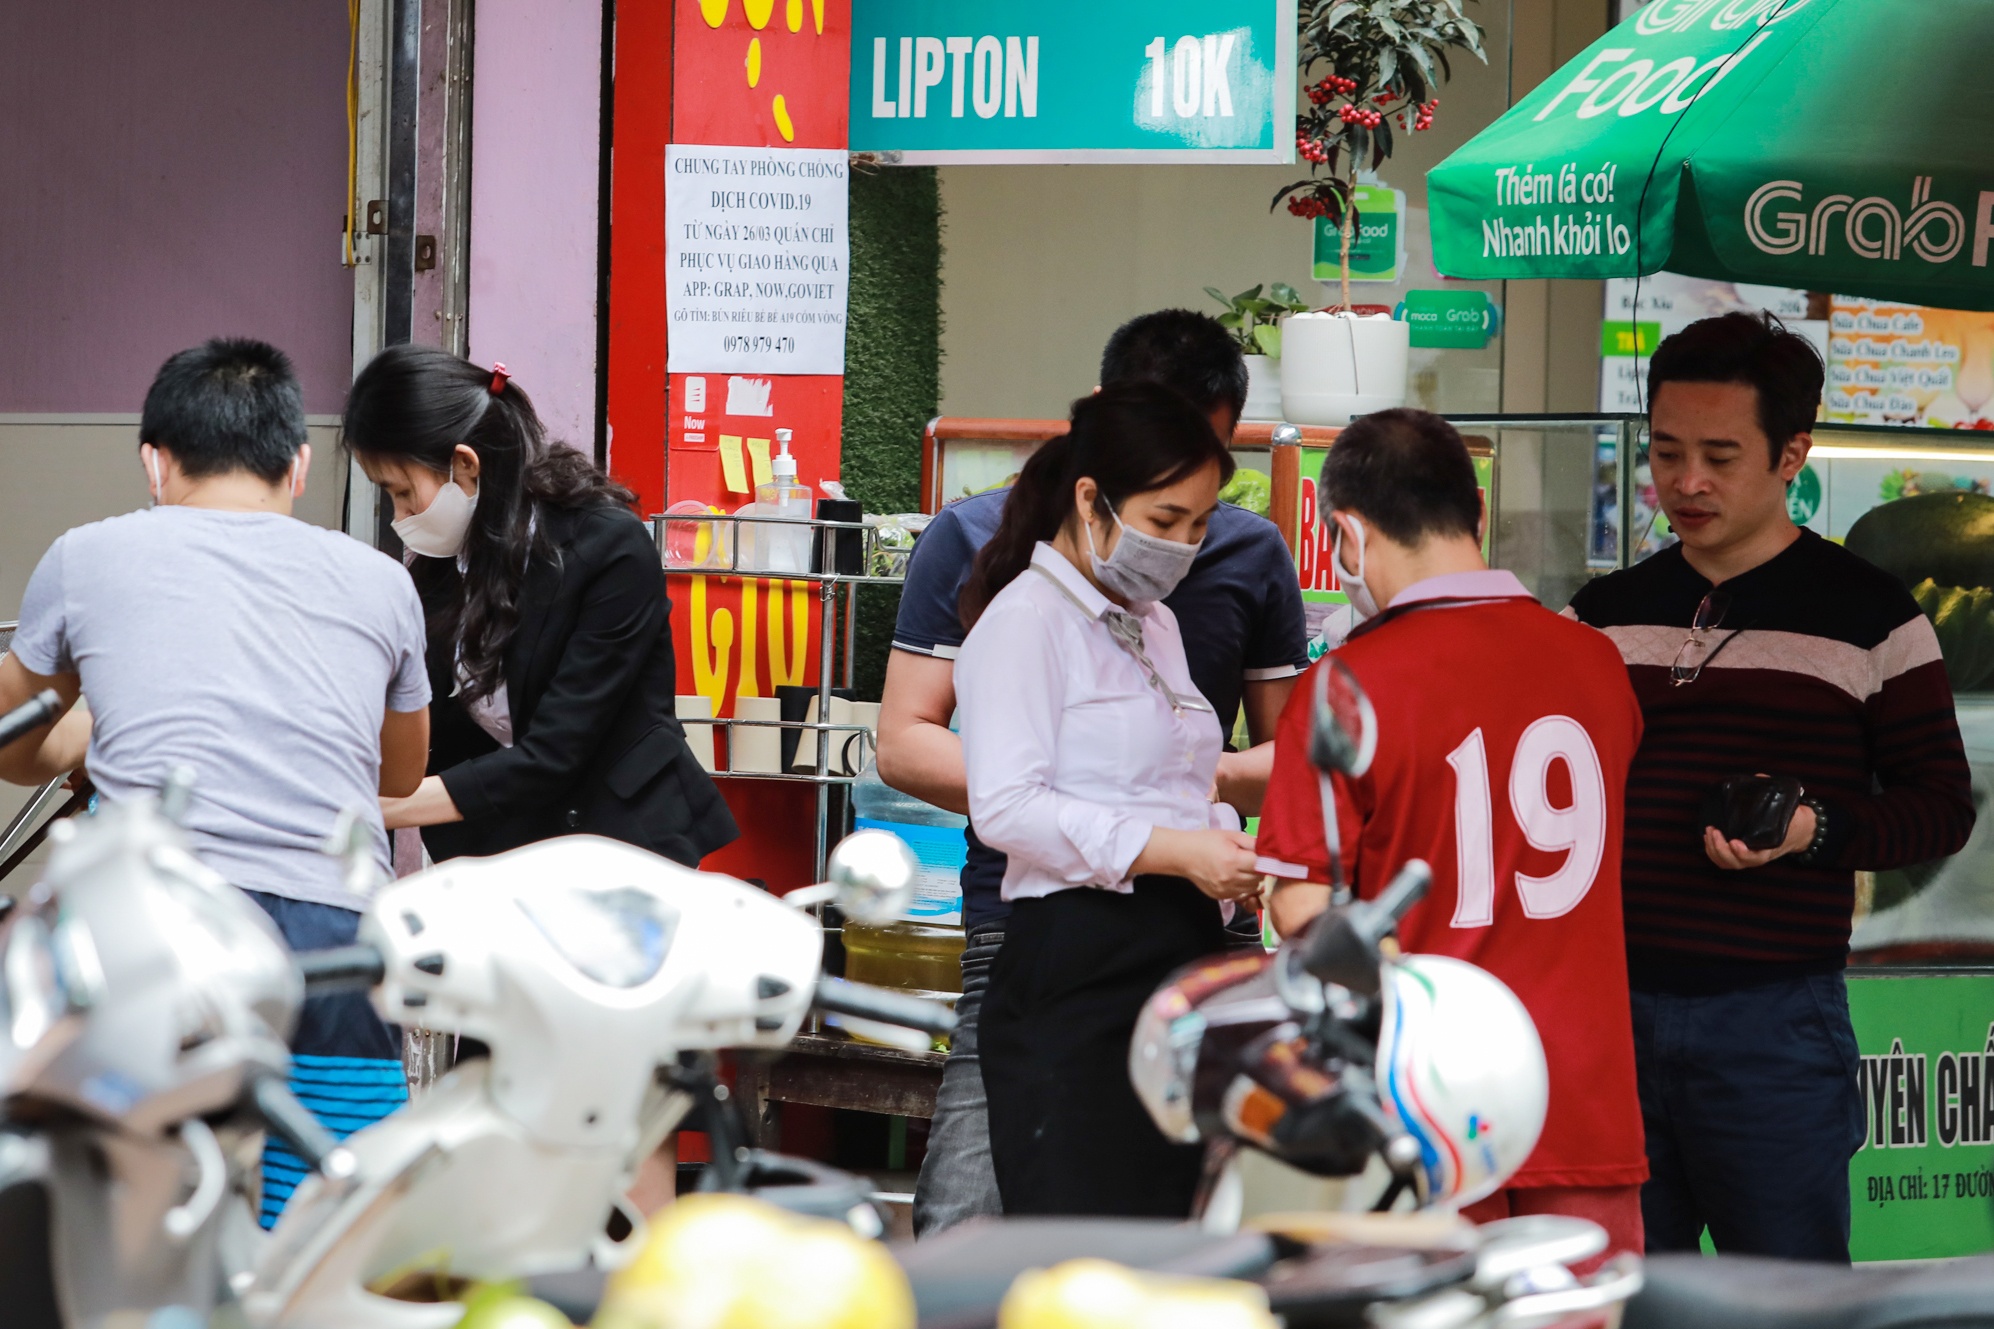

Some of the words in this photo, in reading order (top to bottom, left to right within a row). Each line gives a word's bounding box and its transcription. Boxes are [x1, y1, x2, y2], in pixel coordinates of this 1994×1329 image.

[872, 36, 1038, 118] LIPTON
[1145, 34, 1234, 118] 10K
[1533, 31, 1773, 121] Food
[675, 157, 719, 174] CHUNG
[723, 159, 747, 175] TAY
[751, 156, 796, 177] PHÒNG
[1581, 161, 1617, 203] có!
[711, 191, 746, 212] DỊCH
[749, 191, 811, 210] COVID.19
[684, 219, 702, 240] TỪ
[705, 220, 740, 240] NGÀY
[743, 225, 771, 241] 26/03
[774, 222, 809, 245] QUÁN
[812, 223, 834, 243] CHỈ
[1482, 215, 1550, 257] Nhanh
[1554, 211, 1601, 255] khỏi
[1606, 214, 1631, 255] lo
[680, 252, 714, 272] PHỤC
[717, 253, 735, 273] VỤ
[738, 254, 770, 270] GIAO
[774, 250, 809, 271] HÀNG
[811, 255, 838, 275] QUA
[683, 281, 711, 297] APP:
[714, 281, 753, 300] GRAP,
[756, 282, 835, 300] NOW,GOVIET
[712, 308, 730, 322] BÚN
[780, 312, 794, 324] A19
[1411, 312, 1437, 321] moca
[1446, 307, 1479, 322] Grab
[724, 336, 750, 353] 0978
[753, 336, 772, 353] 979
[775, 337, 795, 353] 470
[684, 415, 705, 430] Now
[1446, 715, 1607, 929] 19
[1868, 1176, 1894, 1208] ĐỊA
[1899, 1166, 1928, 1200] CHỈ:
[1933, 1174, 1951, 1199] 17
